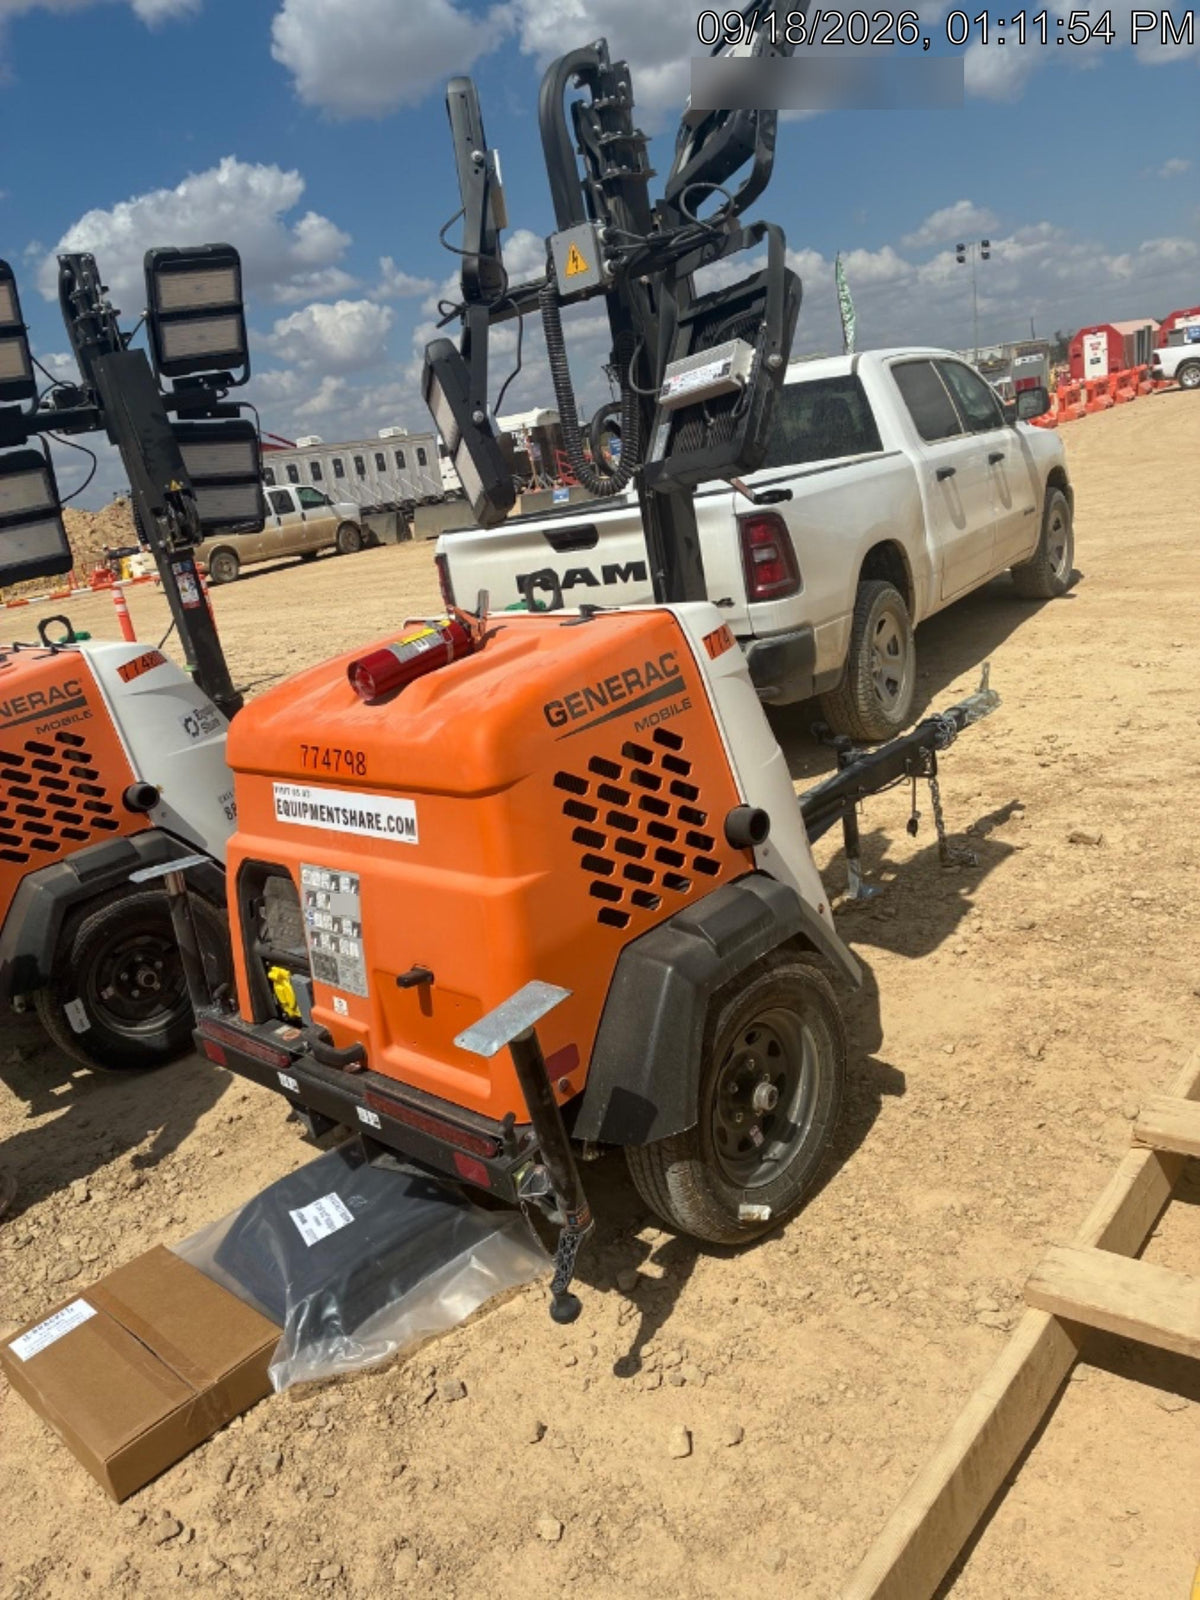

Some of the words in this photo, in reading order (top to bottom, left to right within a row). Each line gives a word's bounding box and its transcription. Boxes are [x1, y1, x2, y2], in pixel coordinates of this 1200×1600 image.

[543, 651, 681, 728] GENERAC
[35, 709, 93, 735] MOBILE
[634, 696, 693, 733] MOBILE
[300, 744, 367, 776] 774798
[276, 798, 417, 837] EQUIPMENTSHARE.COM
